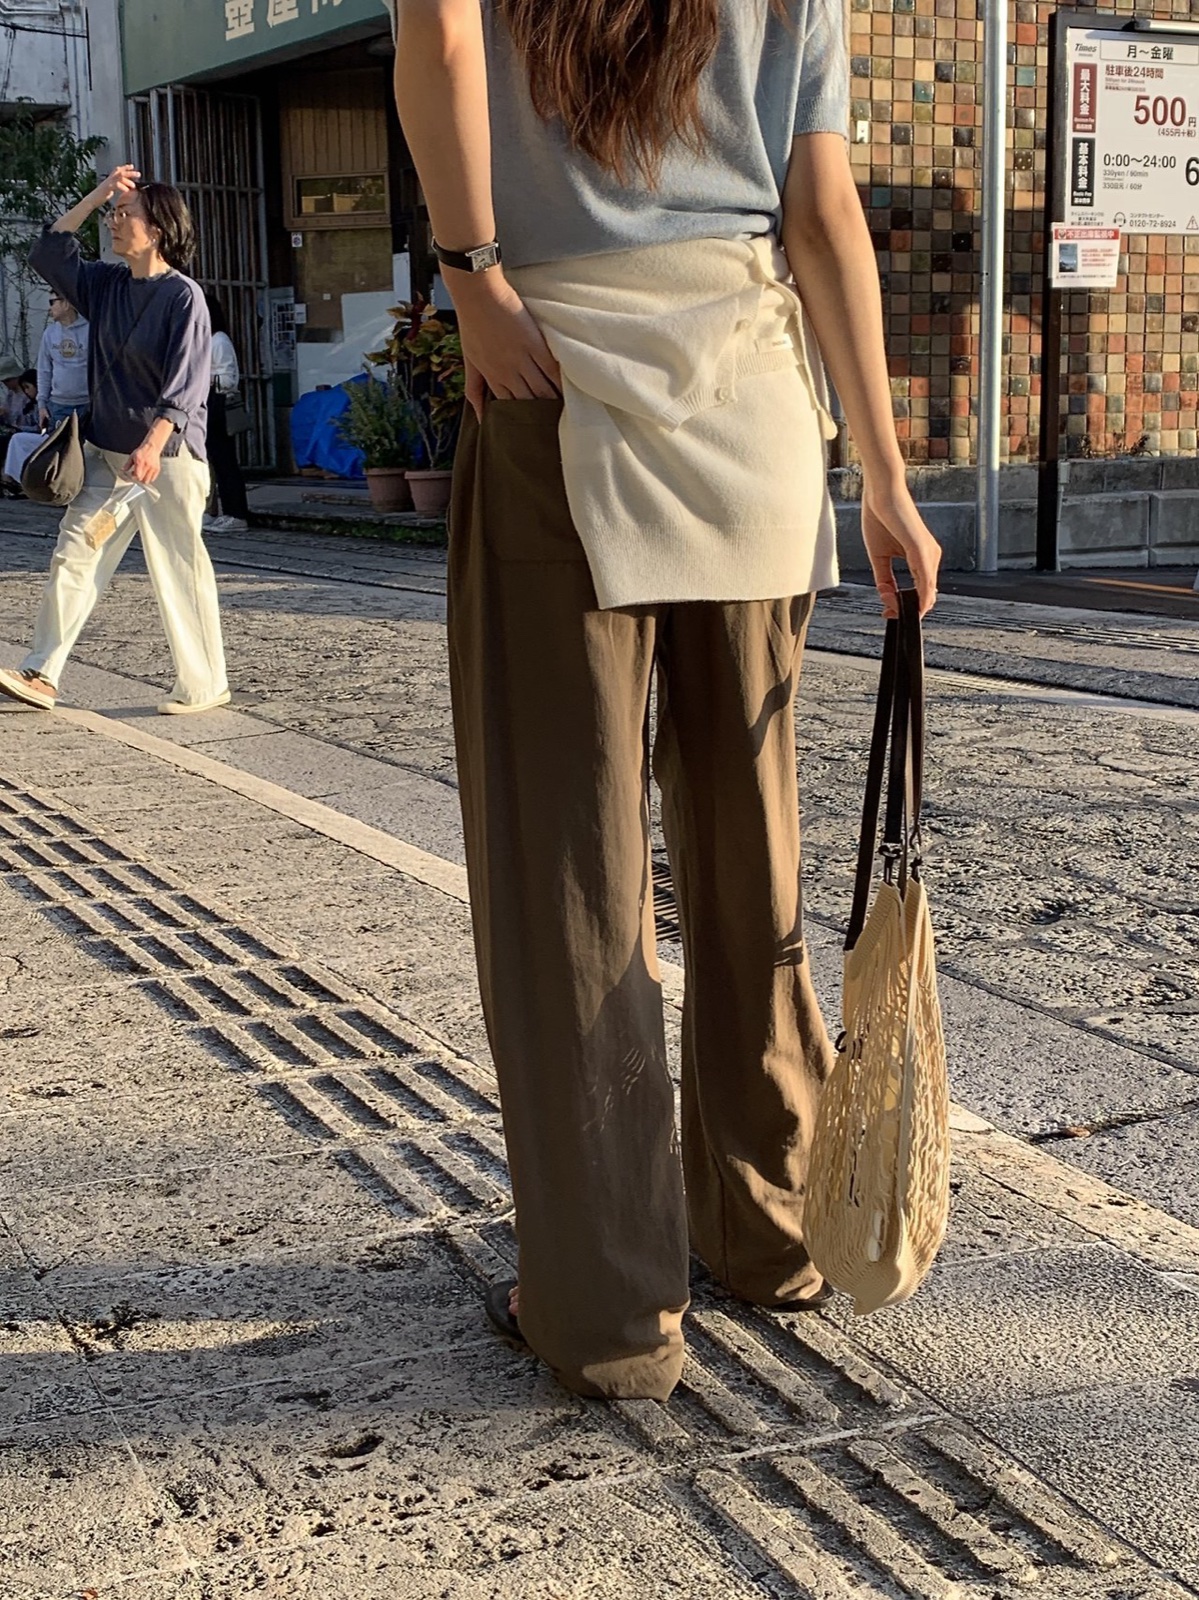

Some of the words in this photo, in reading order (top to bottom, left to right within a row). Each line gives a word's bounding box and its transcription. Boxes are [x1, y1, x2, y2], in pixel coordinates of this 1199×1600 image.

[1074, 43, 1097, 52] Times
[1127, 45, 1174, 60] 月～金曜
[1105, 64, 1164, 79] 駐車後24時間
[1079, 68, 1091, 115] 最大料金
[1078, 142, 1089, 189] 基本料金
[1103, 153, 1177, 168] 0:00～24:00
[1103, 169, 1125, 177] 330yen
[1129, 219, 1176, 227] 0120-72-8924
